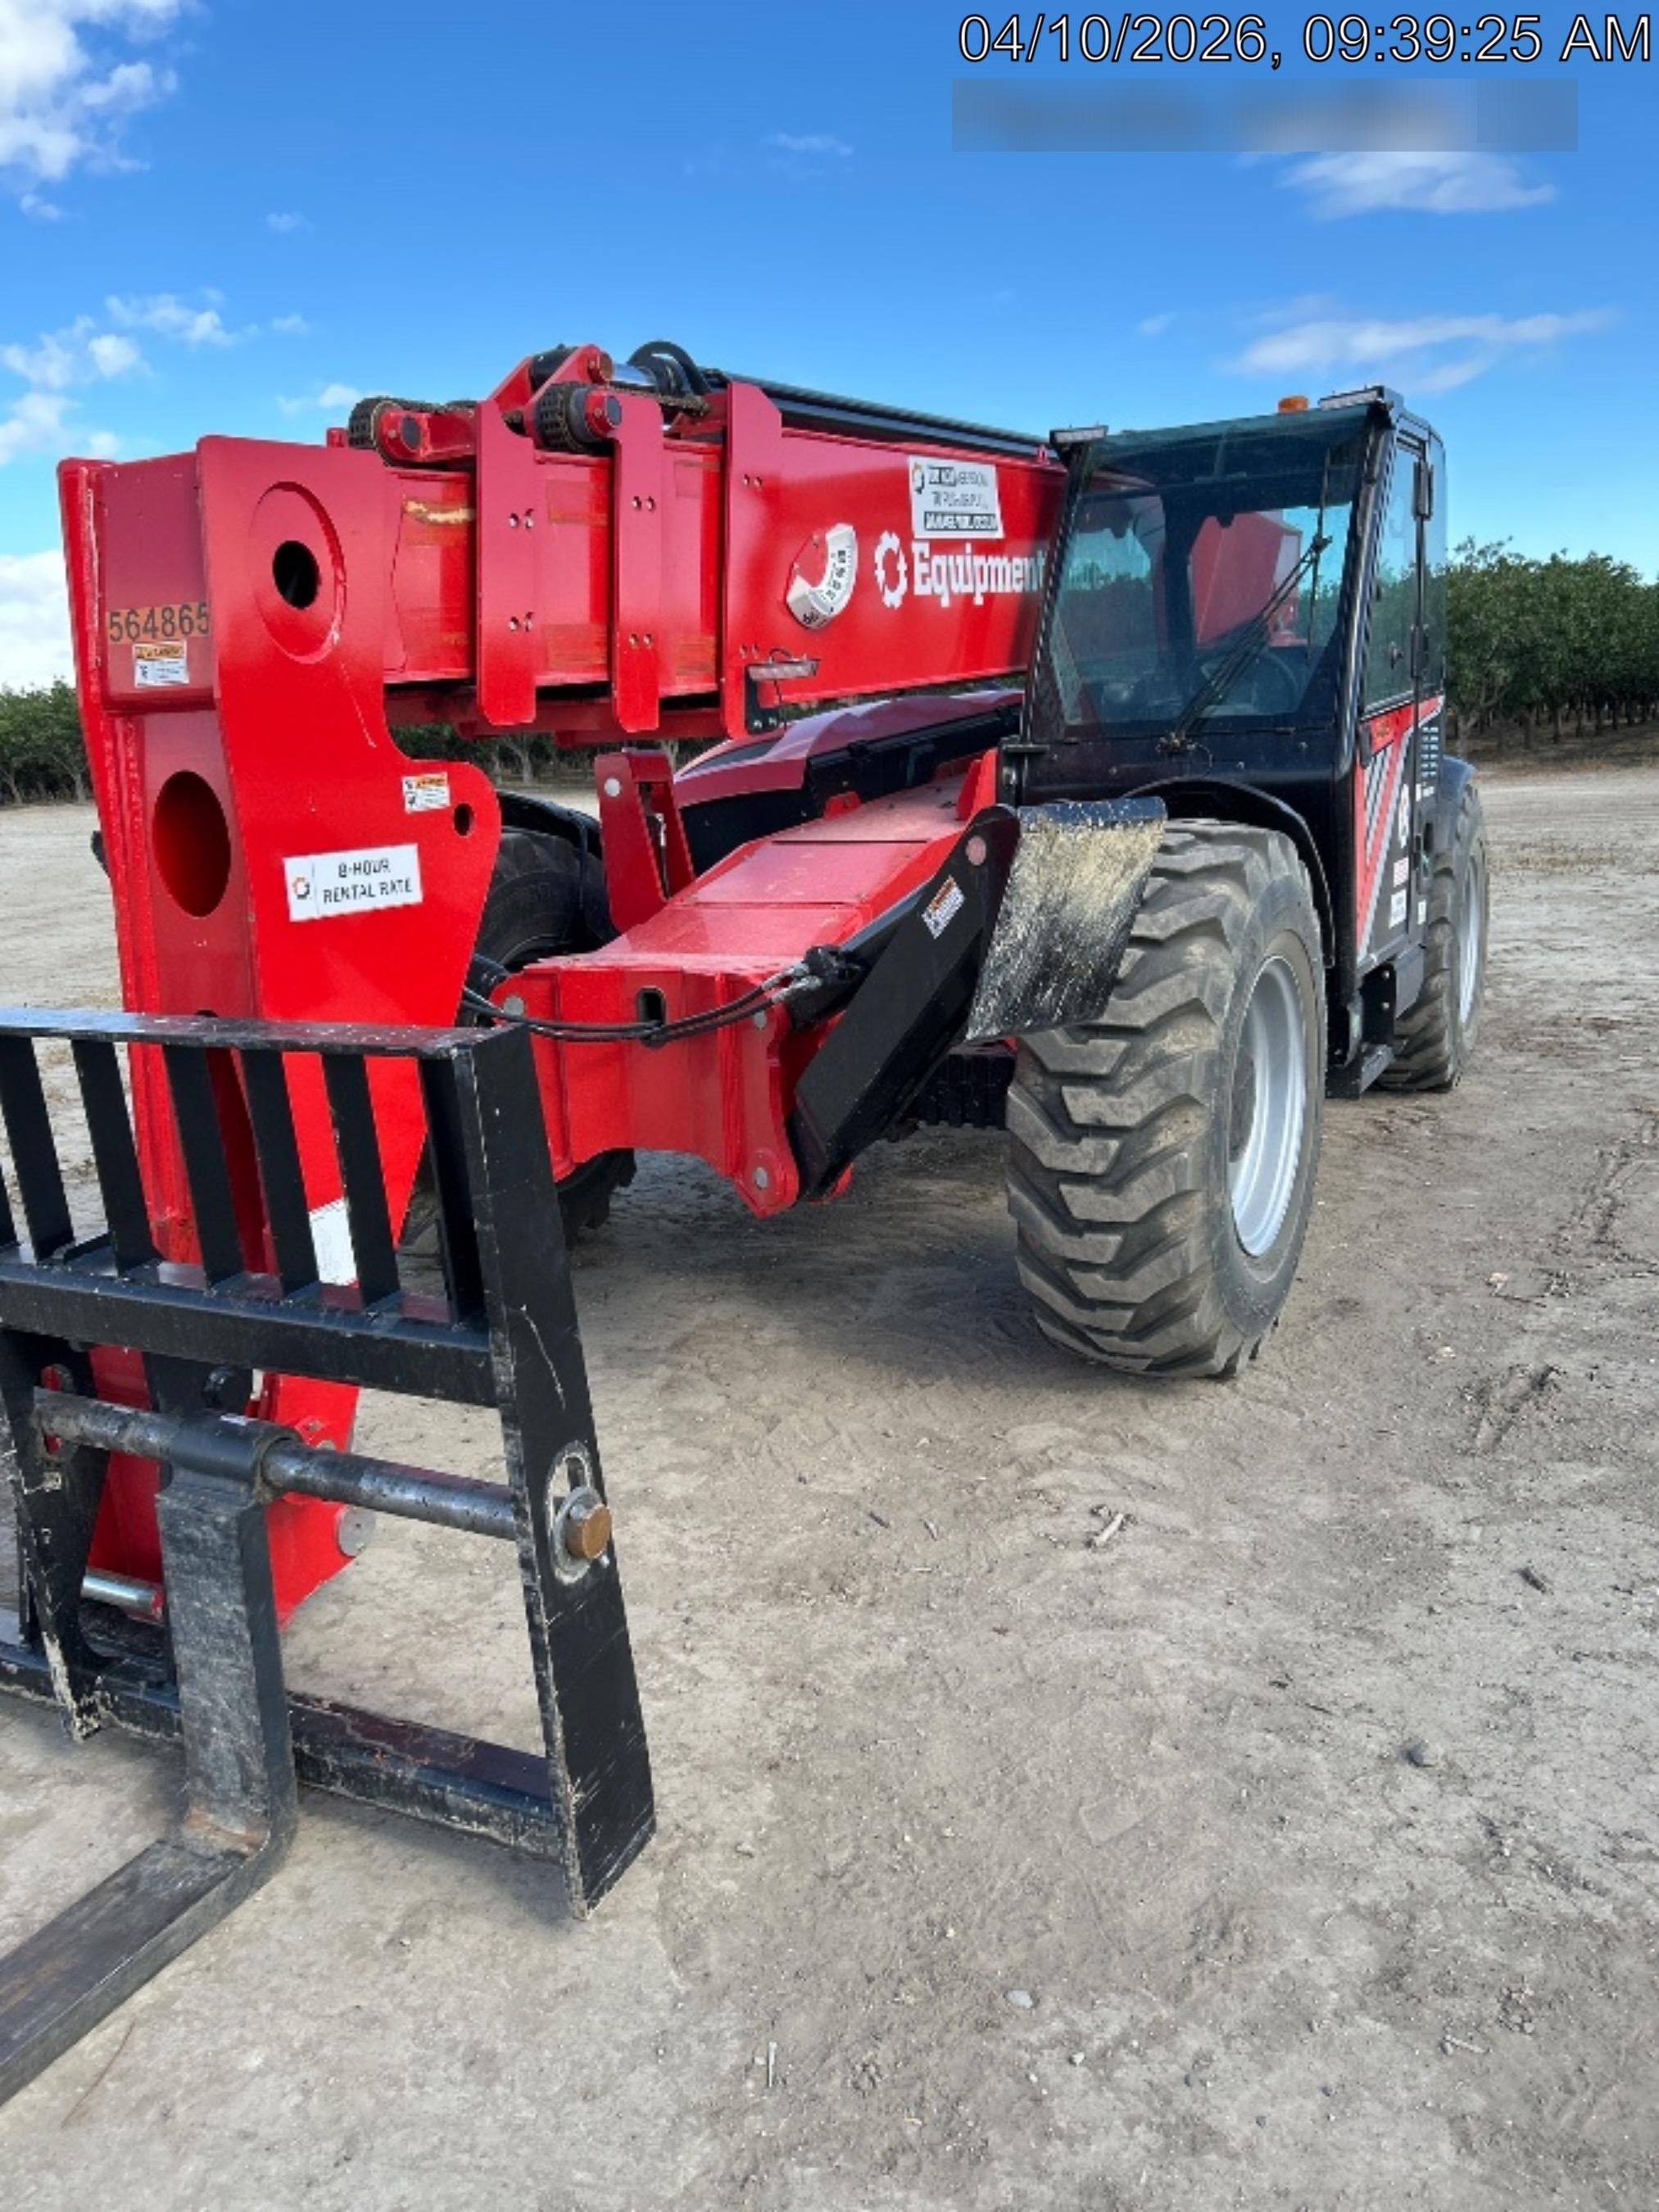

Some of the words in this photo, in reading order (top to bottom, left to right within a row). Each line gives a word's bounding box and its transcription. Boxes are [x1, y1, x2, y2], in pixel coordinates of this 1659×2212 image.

[912, 541, 1045, 607] Equipment
[109, 601, 210, 642] 564865
[338, 858, 391, 878] 8-HOUR
[323, 882, 376, 904] RENTAL
[379, 878, 413, 896] RATE
